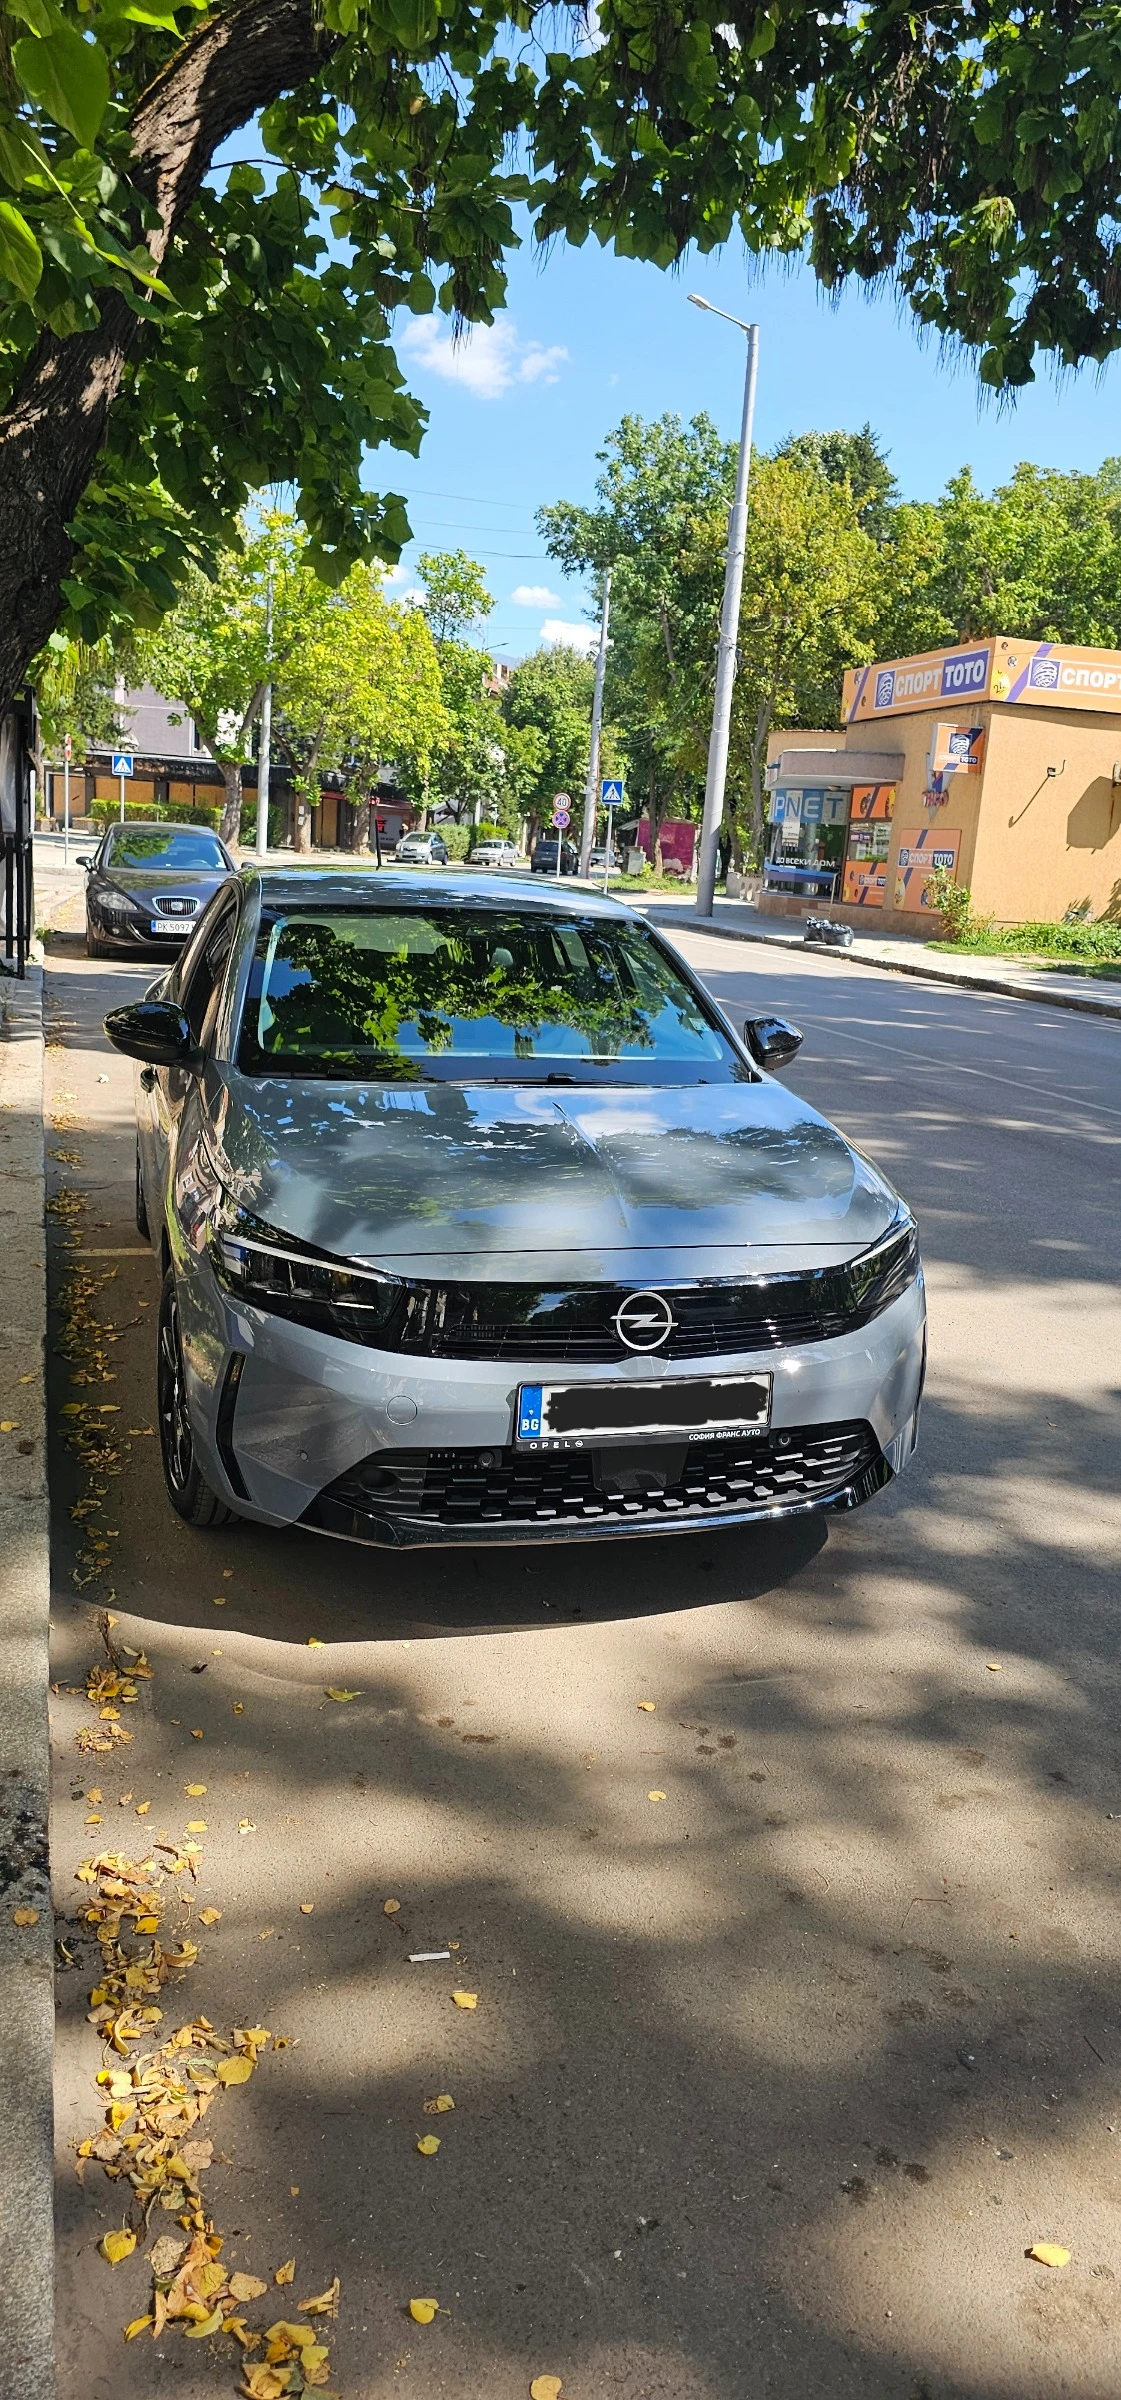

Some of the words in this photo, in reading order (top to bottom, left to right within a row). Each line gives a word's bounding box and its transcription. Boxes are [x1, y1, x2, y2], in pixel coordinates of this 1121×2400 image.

[895, 668, 942, 697] СПОРТ
[945, 659, 985, 688] ТОТО
[557, 798, 567, 806] 40
[909, 852, 932, 864] СПОРТ
[934, 853, 953, 865] ТОТО
[169, 923, 190, 931] 5097
[522, 1418, 540, 1430] BG
[689, 1432, 715, 1441] СОФИЯ
[716, 1430, 741, 1439] ФРАНС
[741, 1428, 761, 1437] АУТО
[529, 1440, 571, 1450] OPEL
